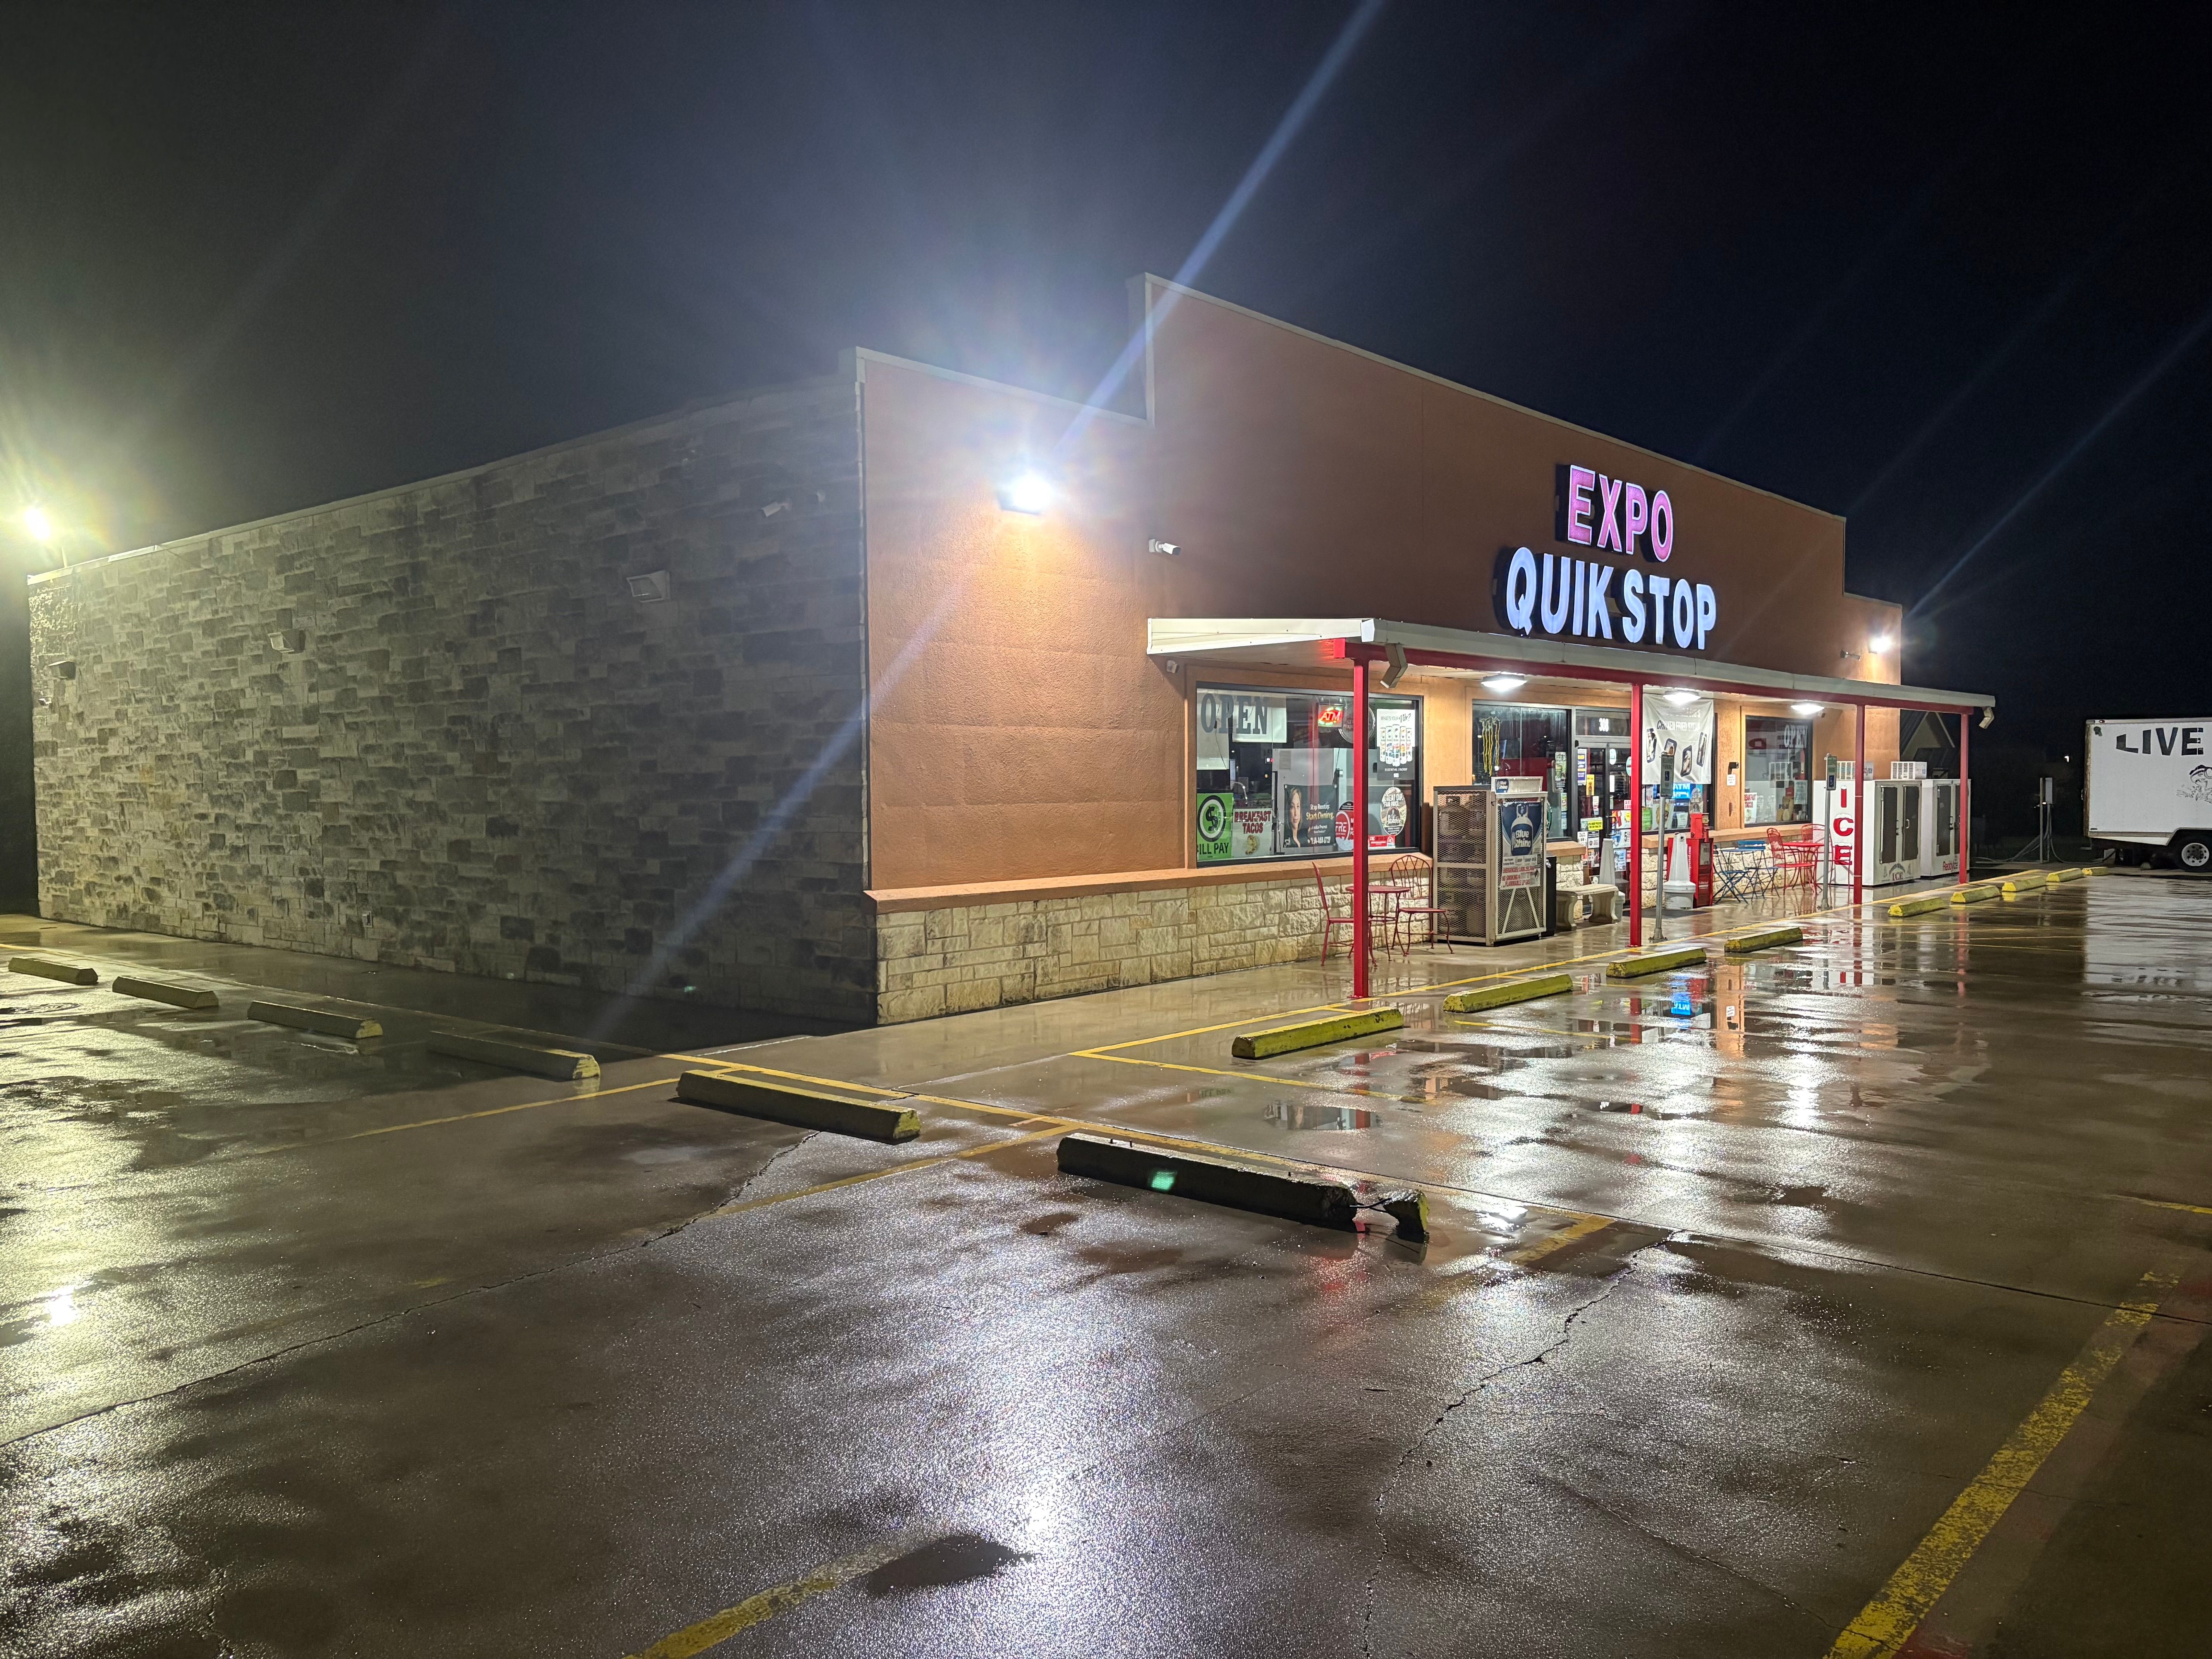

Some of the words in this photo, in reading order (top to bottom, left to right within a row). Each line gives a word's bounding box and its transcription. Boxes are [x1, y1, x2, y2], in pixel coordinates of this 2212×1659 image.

[1568, 465, 1673, 562] EXPO
[1506, 546, 1614, 639] QUIK
[1622, 569, 1716, 650] STOP
[1201, 693, 1270, 735] OPEN
[1320, 711, 1341, 721] ATM
[1599, 718, 1609, 732] 308
[1784, 725, 1808, 749] OPEN
[2116, 727, 2203, 756] LIVE
[1234, 811, 1271, 823] BREAKFAST
[1306, 812, 1317, 820] Start
[1242, 823, 1264, 834] TACOS
[1833, 785, 1854, 865] ICE
[1516, 829, 1530, 838] Blue
[1214, 842, 1229, 854] PAY
[1514, 838, 1531, 848] Rhino
[1892, 872, 1903, 881] ICE
